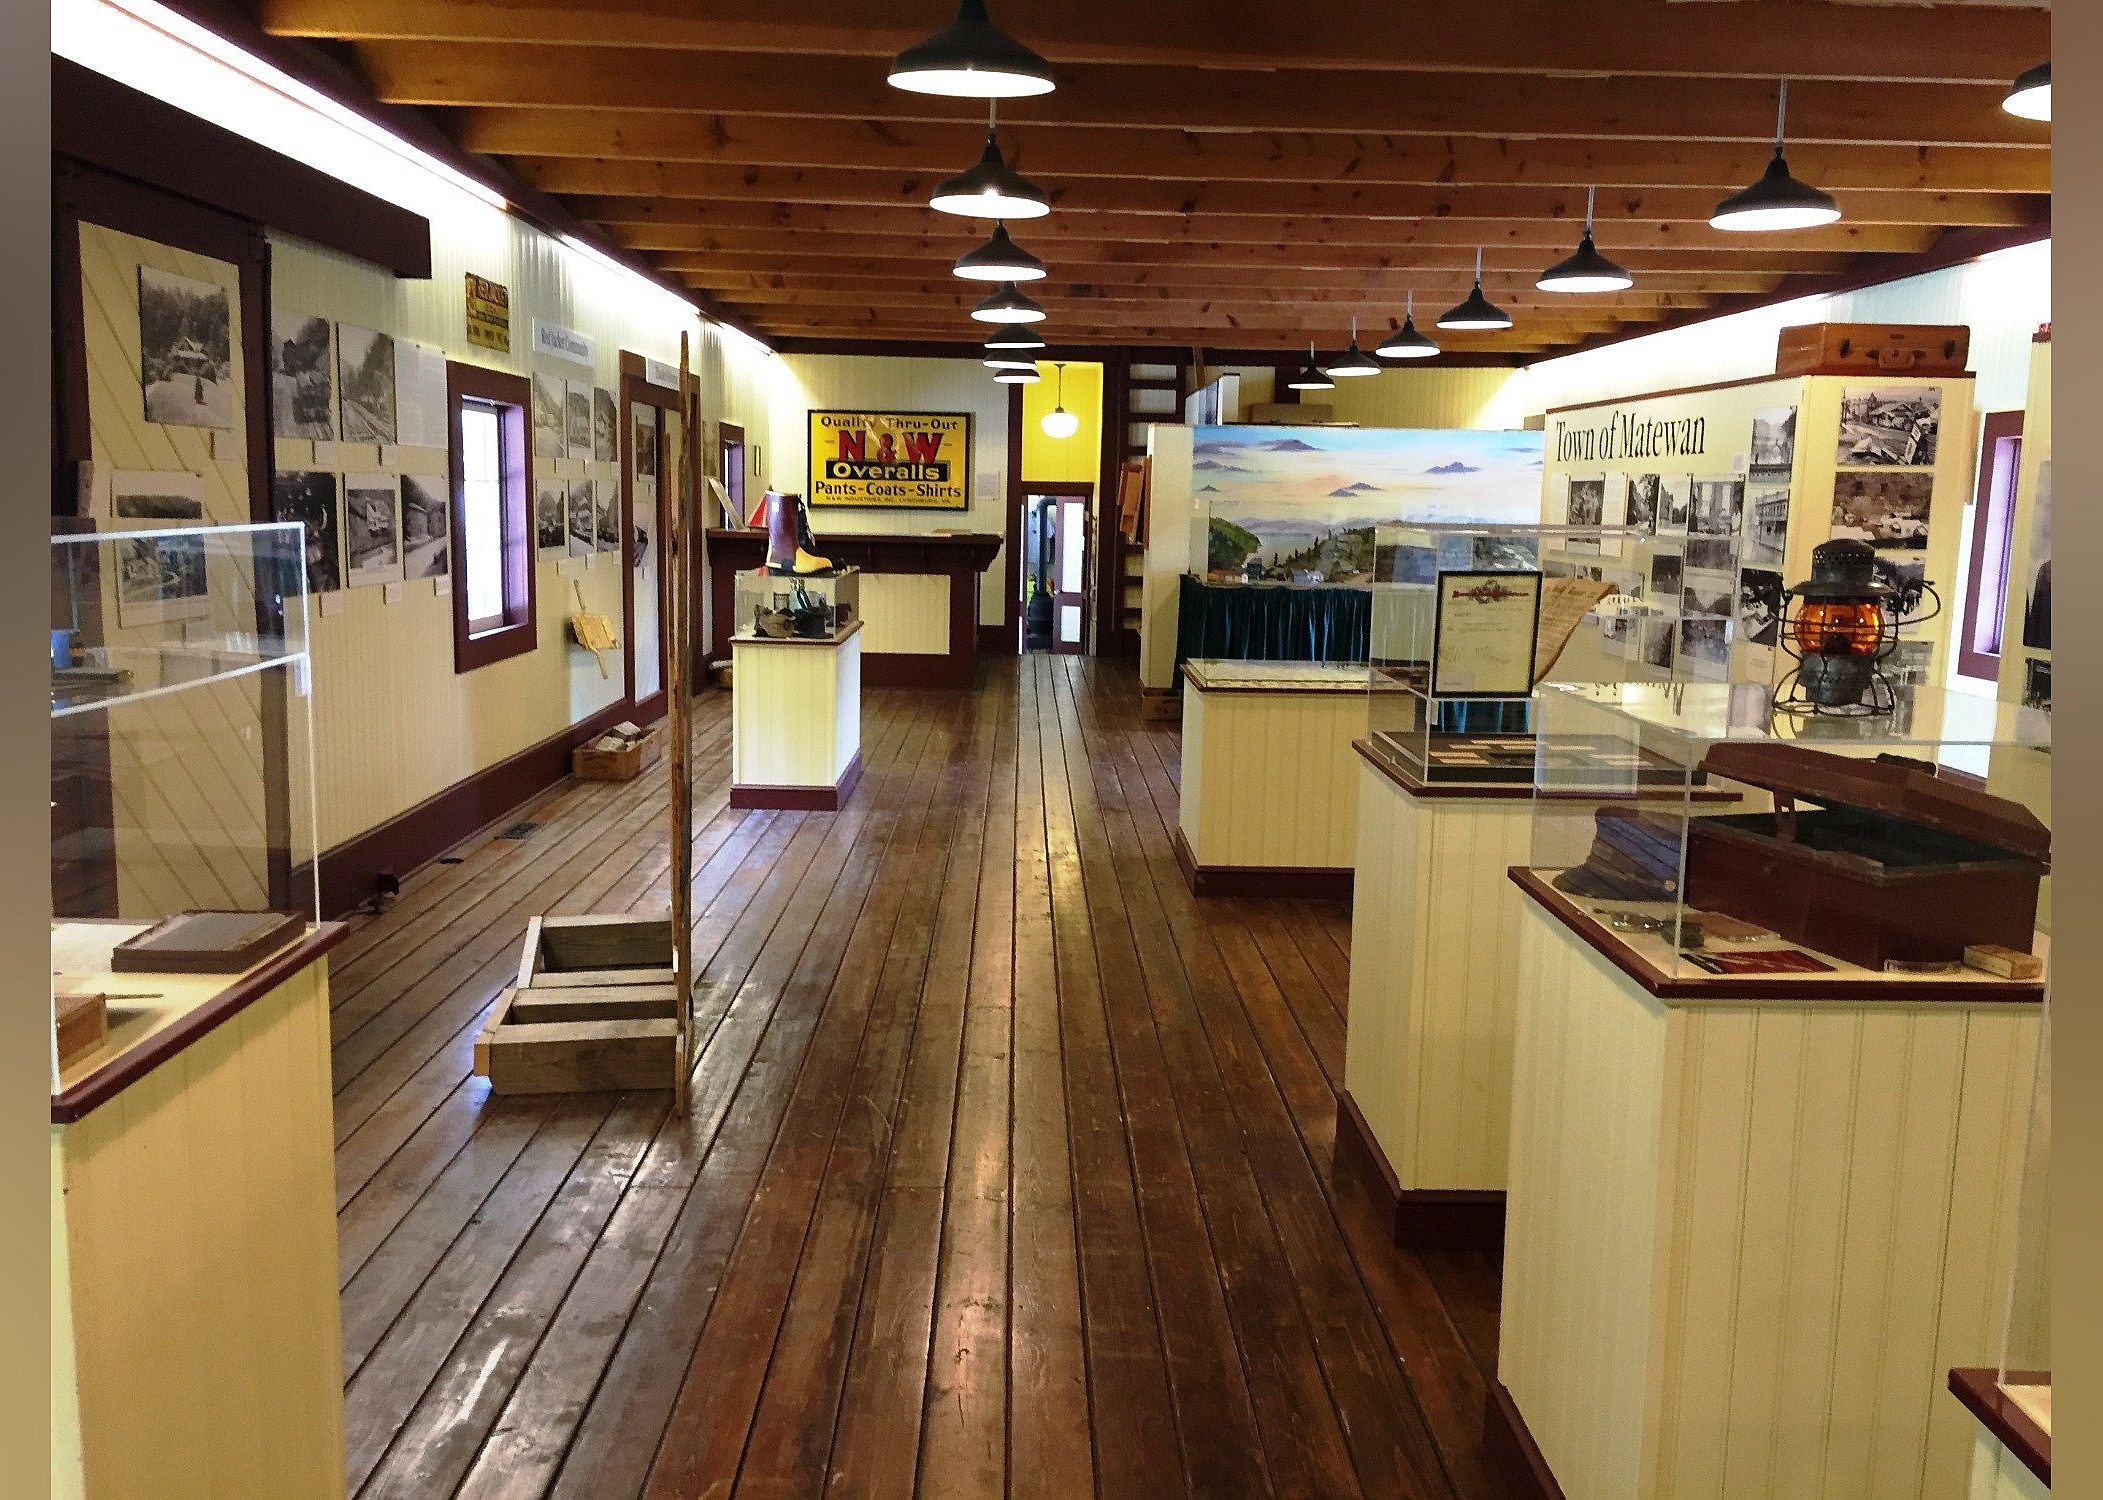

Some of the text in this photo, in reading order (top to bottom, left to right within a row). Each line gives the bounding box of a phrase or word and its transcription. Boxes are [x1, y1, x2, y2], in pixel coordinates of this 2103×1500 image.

[1556, 410, 1706, 462] Town of Matewan
[832, 462, 941, 481] Overalls
